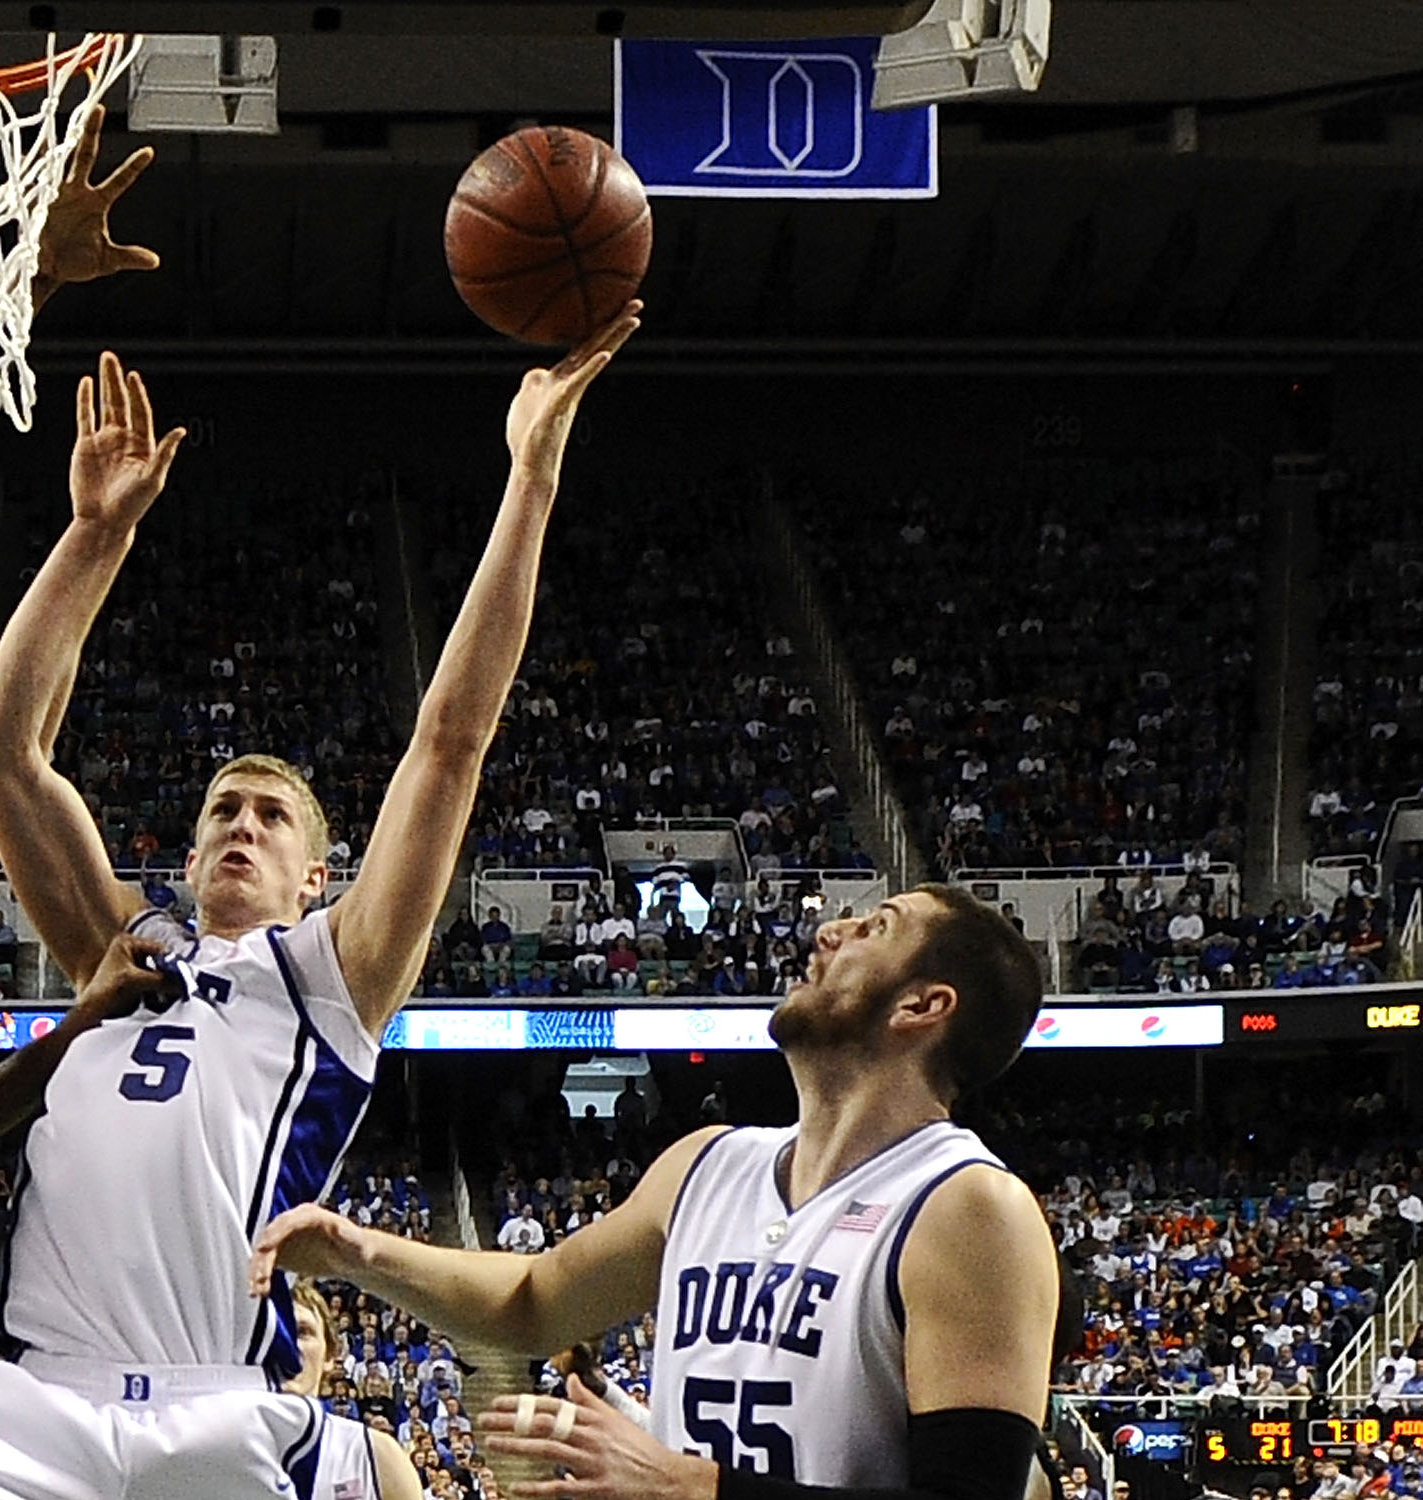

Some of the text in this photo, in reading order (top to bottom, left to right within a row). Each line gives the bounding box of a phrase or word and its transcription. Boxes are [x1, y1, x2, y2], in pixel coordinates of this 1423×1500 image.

[1033, 416, 1082, 447] 239
[1367, 1005, 1420, 1028] DUKE
[118, 1025, 195, 1102] 5
[673, 1261, 839, 1358] DUKE
[682, 1376, 796, 1481] 55
[1327, 1419, 1380, 1444] 7:18
[1260, 1436, 1291, 1460] 21
